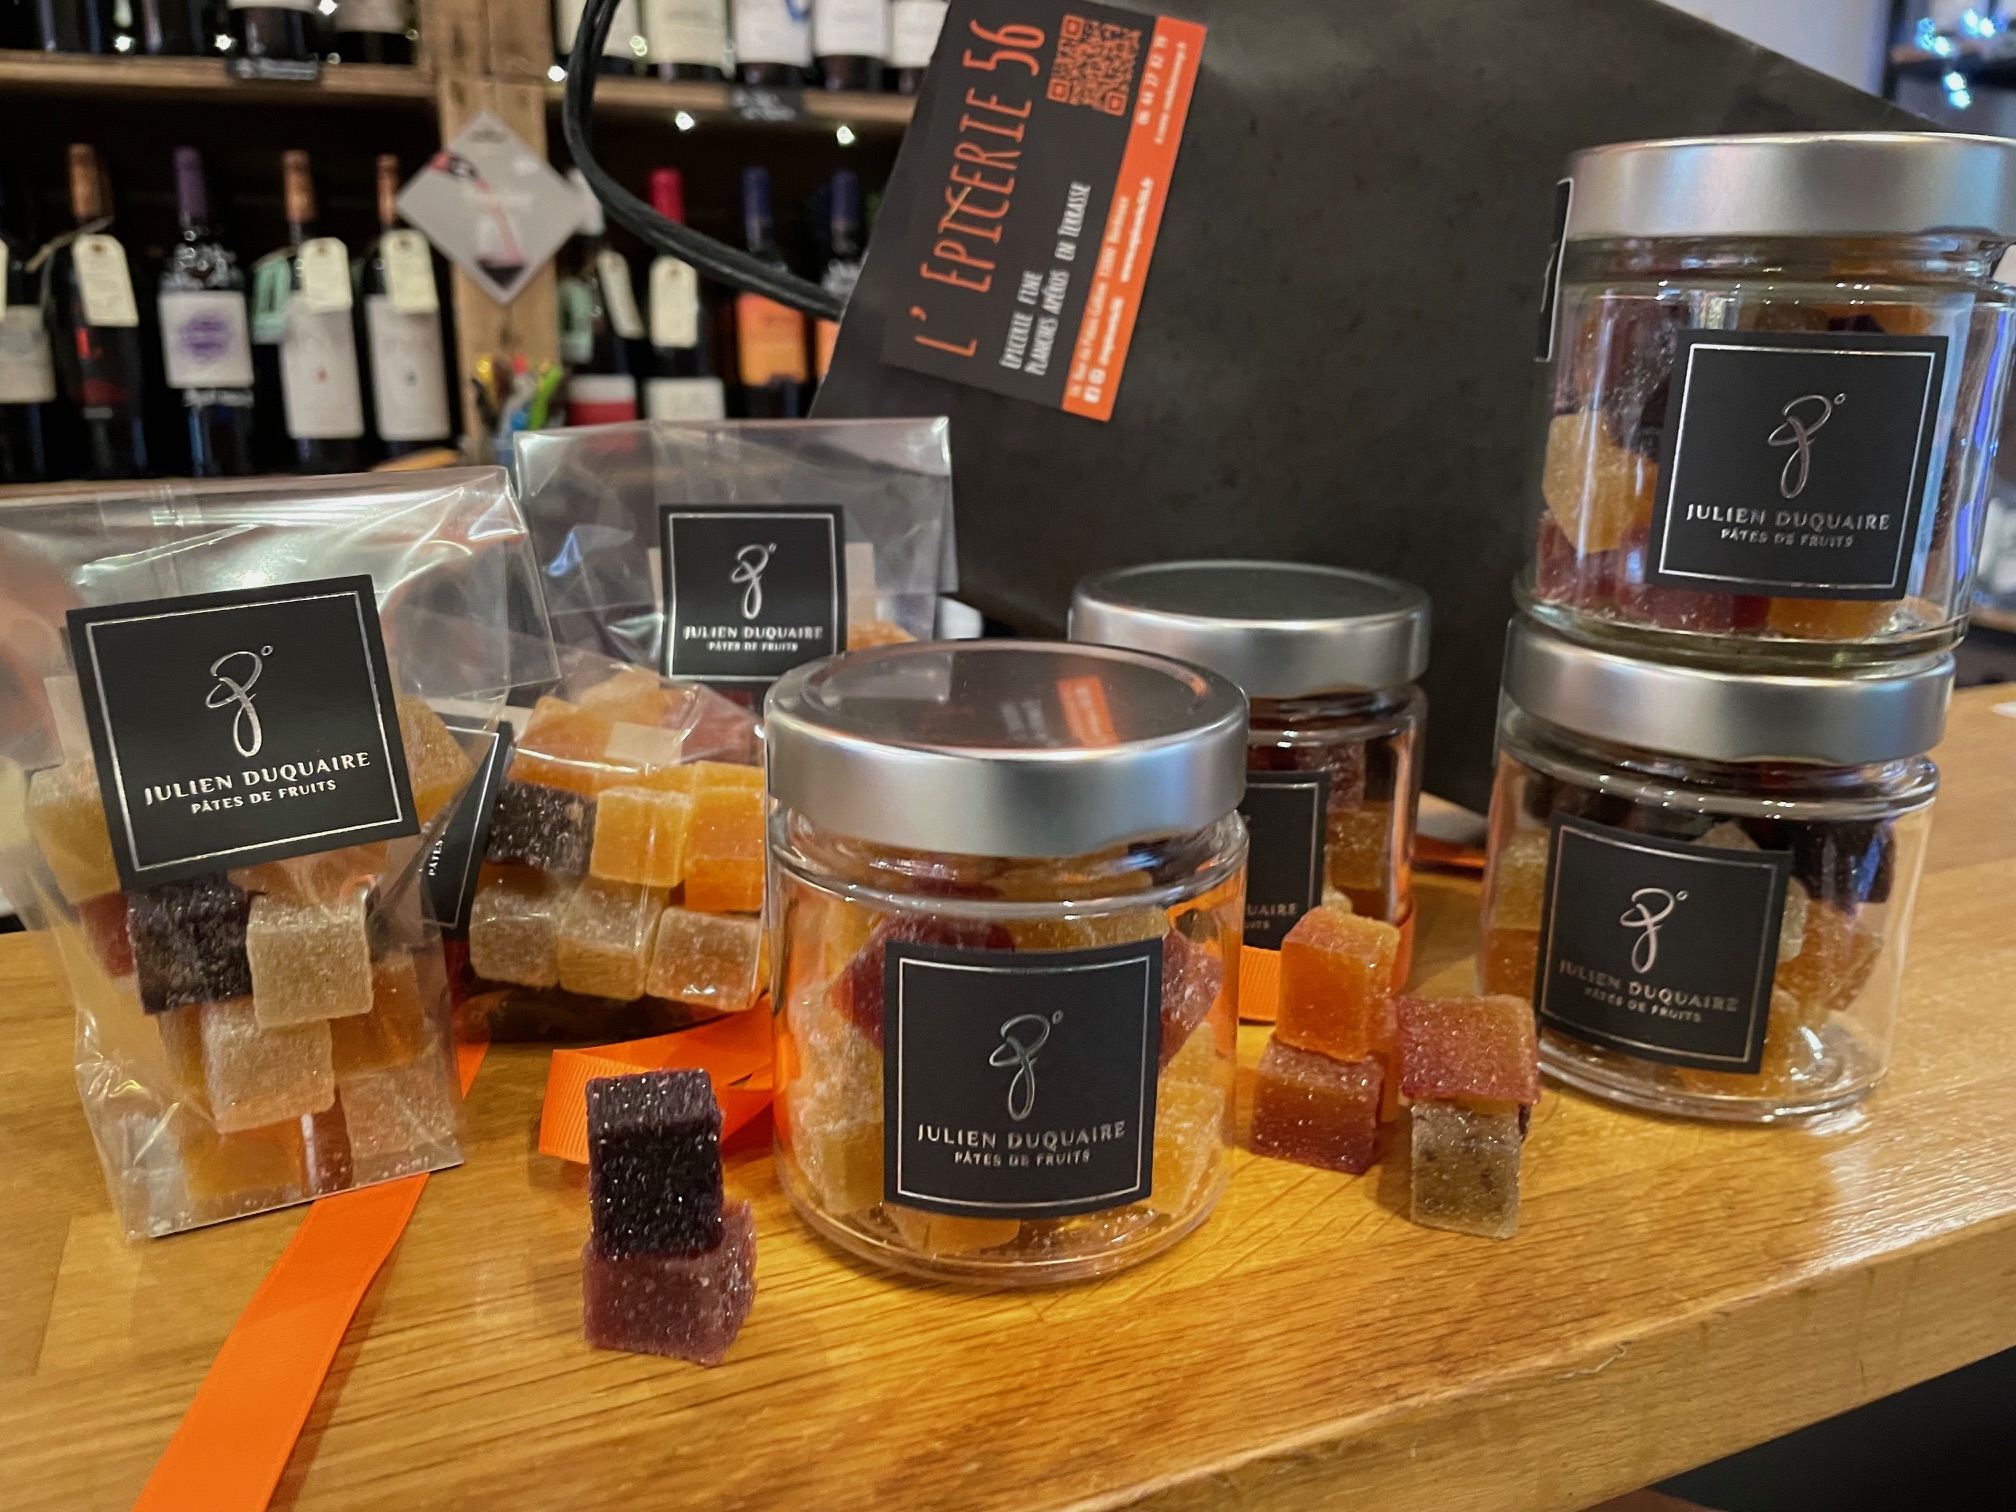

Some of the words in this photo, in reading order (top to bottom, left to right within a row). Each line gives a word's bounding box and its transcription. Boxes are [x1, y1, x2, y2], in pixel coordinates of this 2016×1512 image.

[962, 20, 1045, 76] 56
[921, 88, 1031, 292] EPICERIE
[1687, 504, 1766, 524] JULIEN
[1776, 510, 1890, 533] DUQUAIRE
[1721, 528, 1768, 543] PÂTES
[1774, 532, 1795, 544] DE
[1800, 534, 1853, 547] FRUITS
[684, 626, 737, 639] JULIEN
[744, 626, 823, 639] DUQUAIRE
[145, 775, 232, 805] JULIEN
[243, 753, 370, 786] DUQUAIRE
[192, 797, 243, 813] PÂTES
[251, 792, 272, 803] DE
[279, 780, 337, 798] FRUITS
[1247, 903, 1297, 916] UAIRE
[1560, 959, 1621, 989] JULIEN
[1629, 981, 1739, 1011] DUQUAIRE
[918, 1124, 996, 1148] JULIEN
[1008, 1121, 1125, 1150] DUQUAIRE
[955, 1151, 1001, 1166] PÂTES
[1009, 1154, 1029, 1166] DE
[1037, 1150, 1090, 1166] FRUITS
